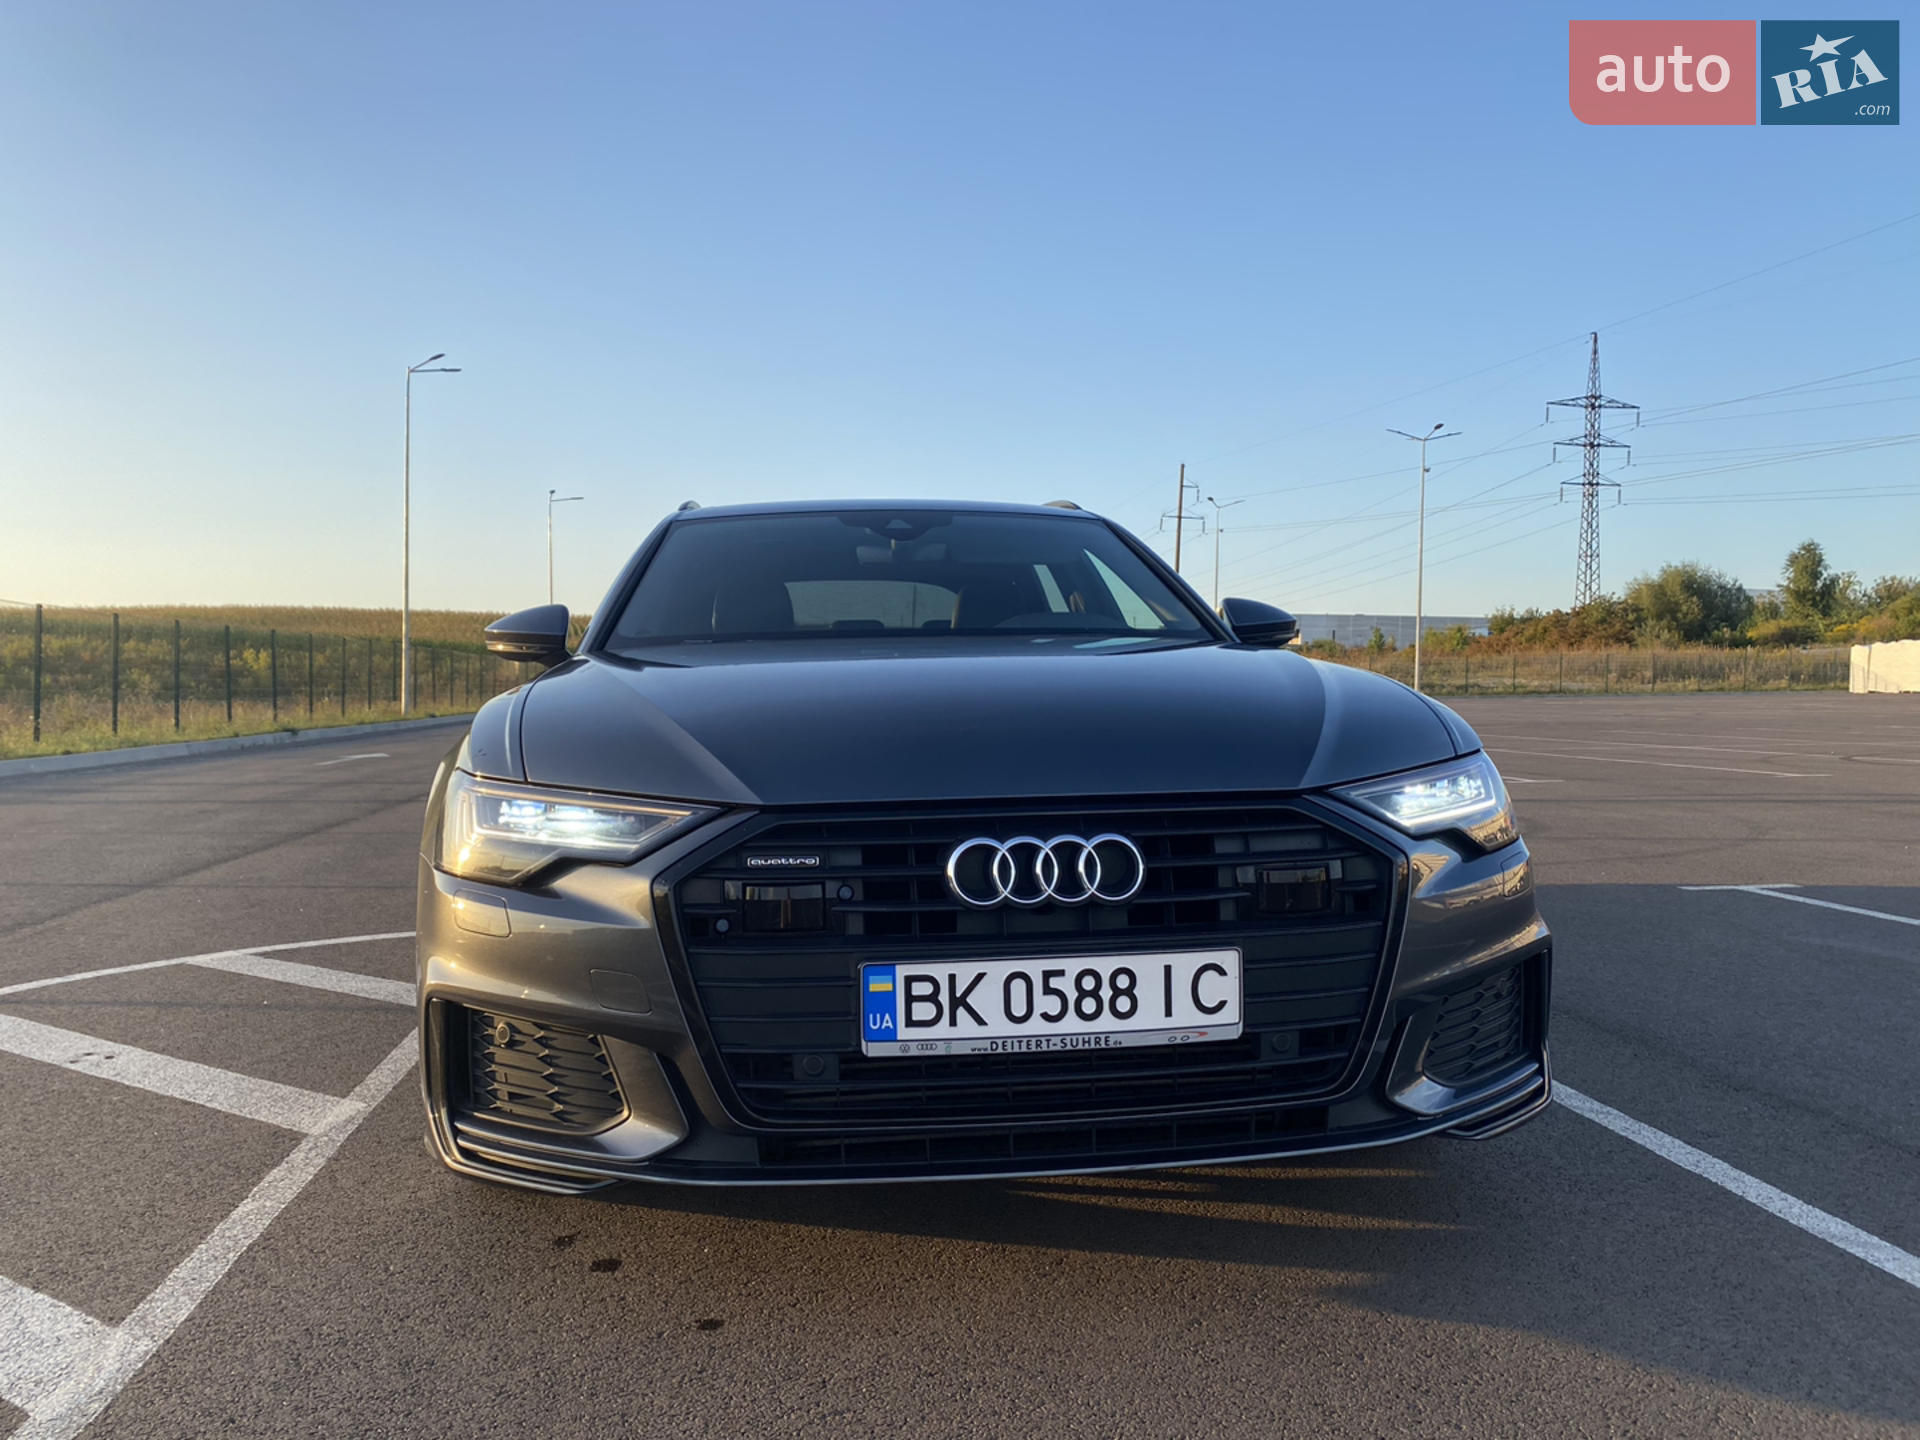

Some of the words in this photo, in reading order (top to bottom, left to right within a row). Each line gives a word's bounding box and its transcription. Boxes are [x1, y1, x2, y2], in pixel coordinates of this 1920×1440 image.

[750, 856, 816, 866] quattro
[904, 971, 988, 1028] BK
[1003, 966, 1138, 1024] 0588
[1163, 963, 1228, 1018] IC
[869, 1013, 893, 1030] UA
